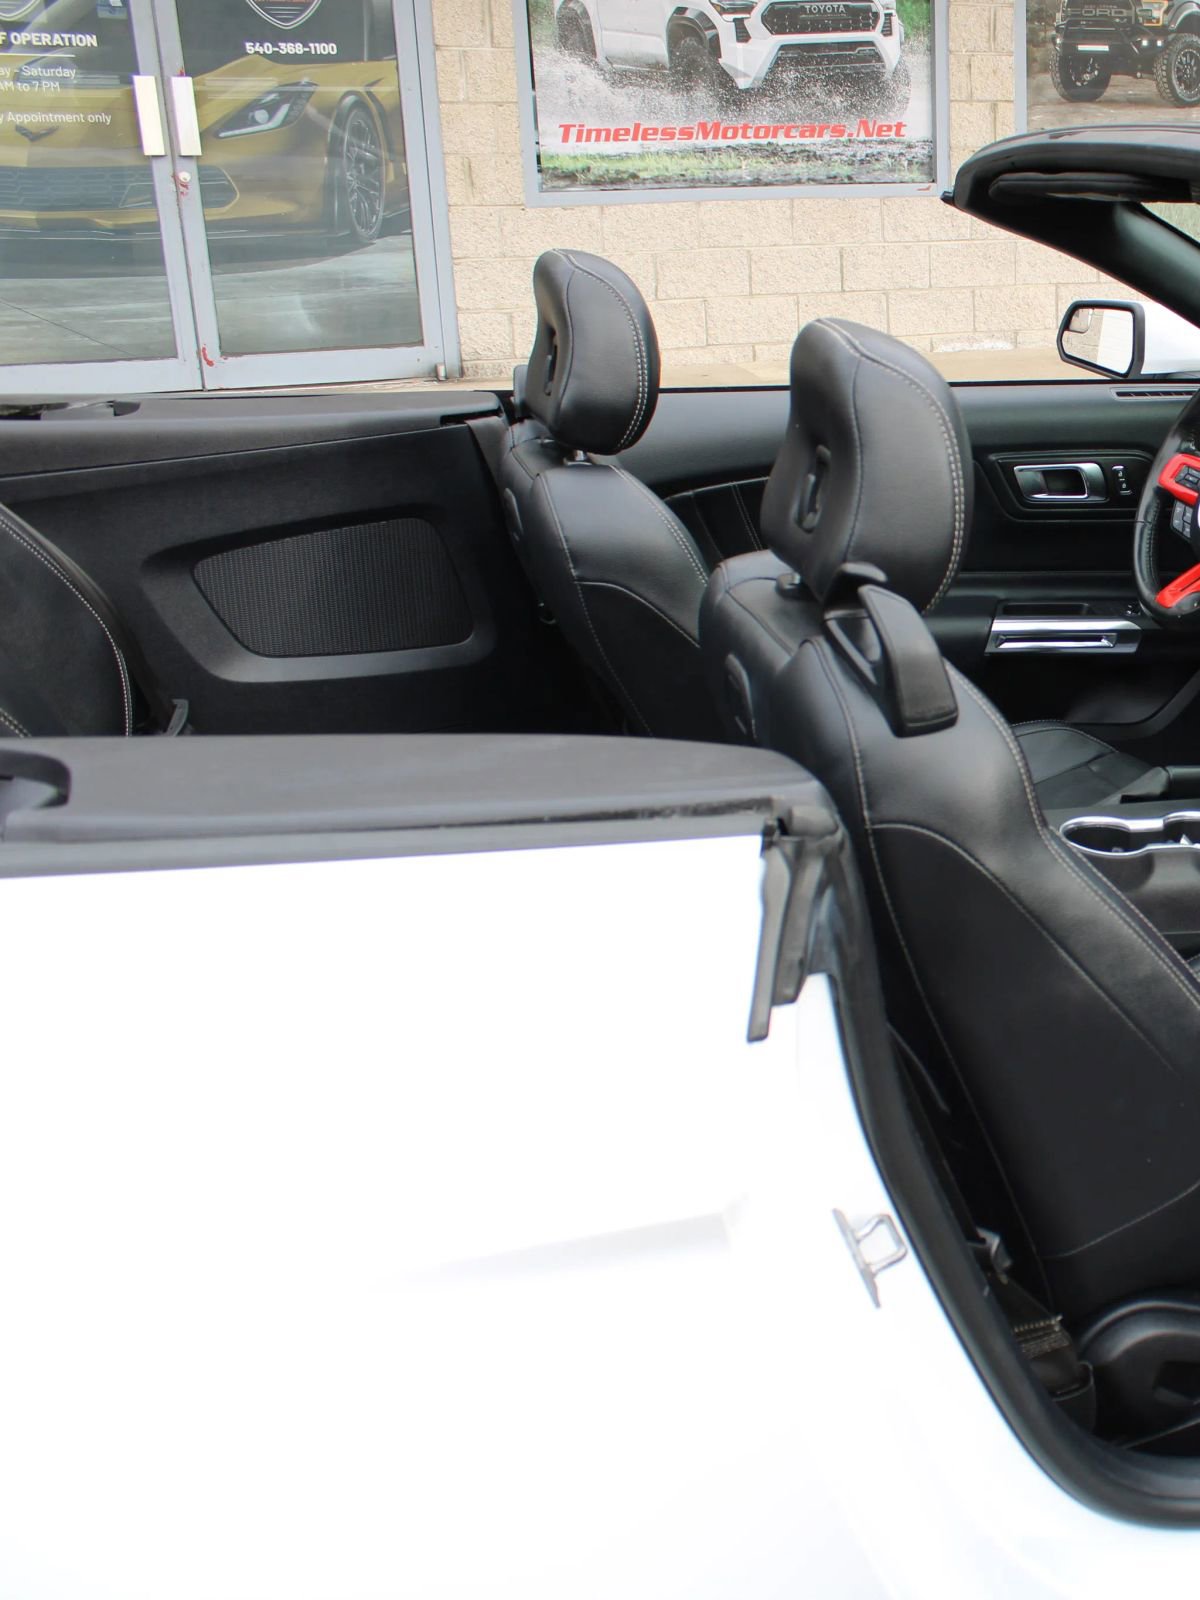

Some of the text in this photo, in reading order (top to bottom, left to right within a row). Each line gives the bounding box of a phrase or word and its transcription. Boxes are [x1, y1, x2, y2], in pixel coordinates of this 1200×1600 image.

[805, 4, 846, 14] TOYOTA
[1066, 8, 1127, 17] FORD
[10, 32, 98, 47] OPERATION
[245, 42, 338, 55] 540-368-1100
[22, 65, 76, 79] Saturday
[17, 82, 30, 92] to
[32, 81, 39, 92] 7
[42, 82, 61, 92] PM
[7, 111, 85, 126] Appointment
[88, 112, 112, 126] only
[558, 119, 907, 144] TimelessMotorcars.Net
